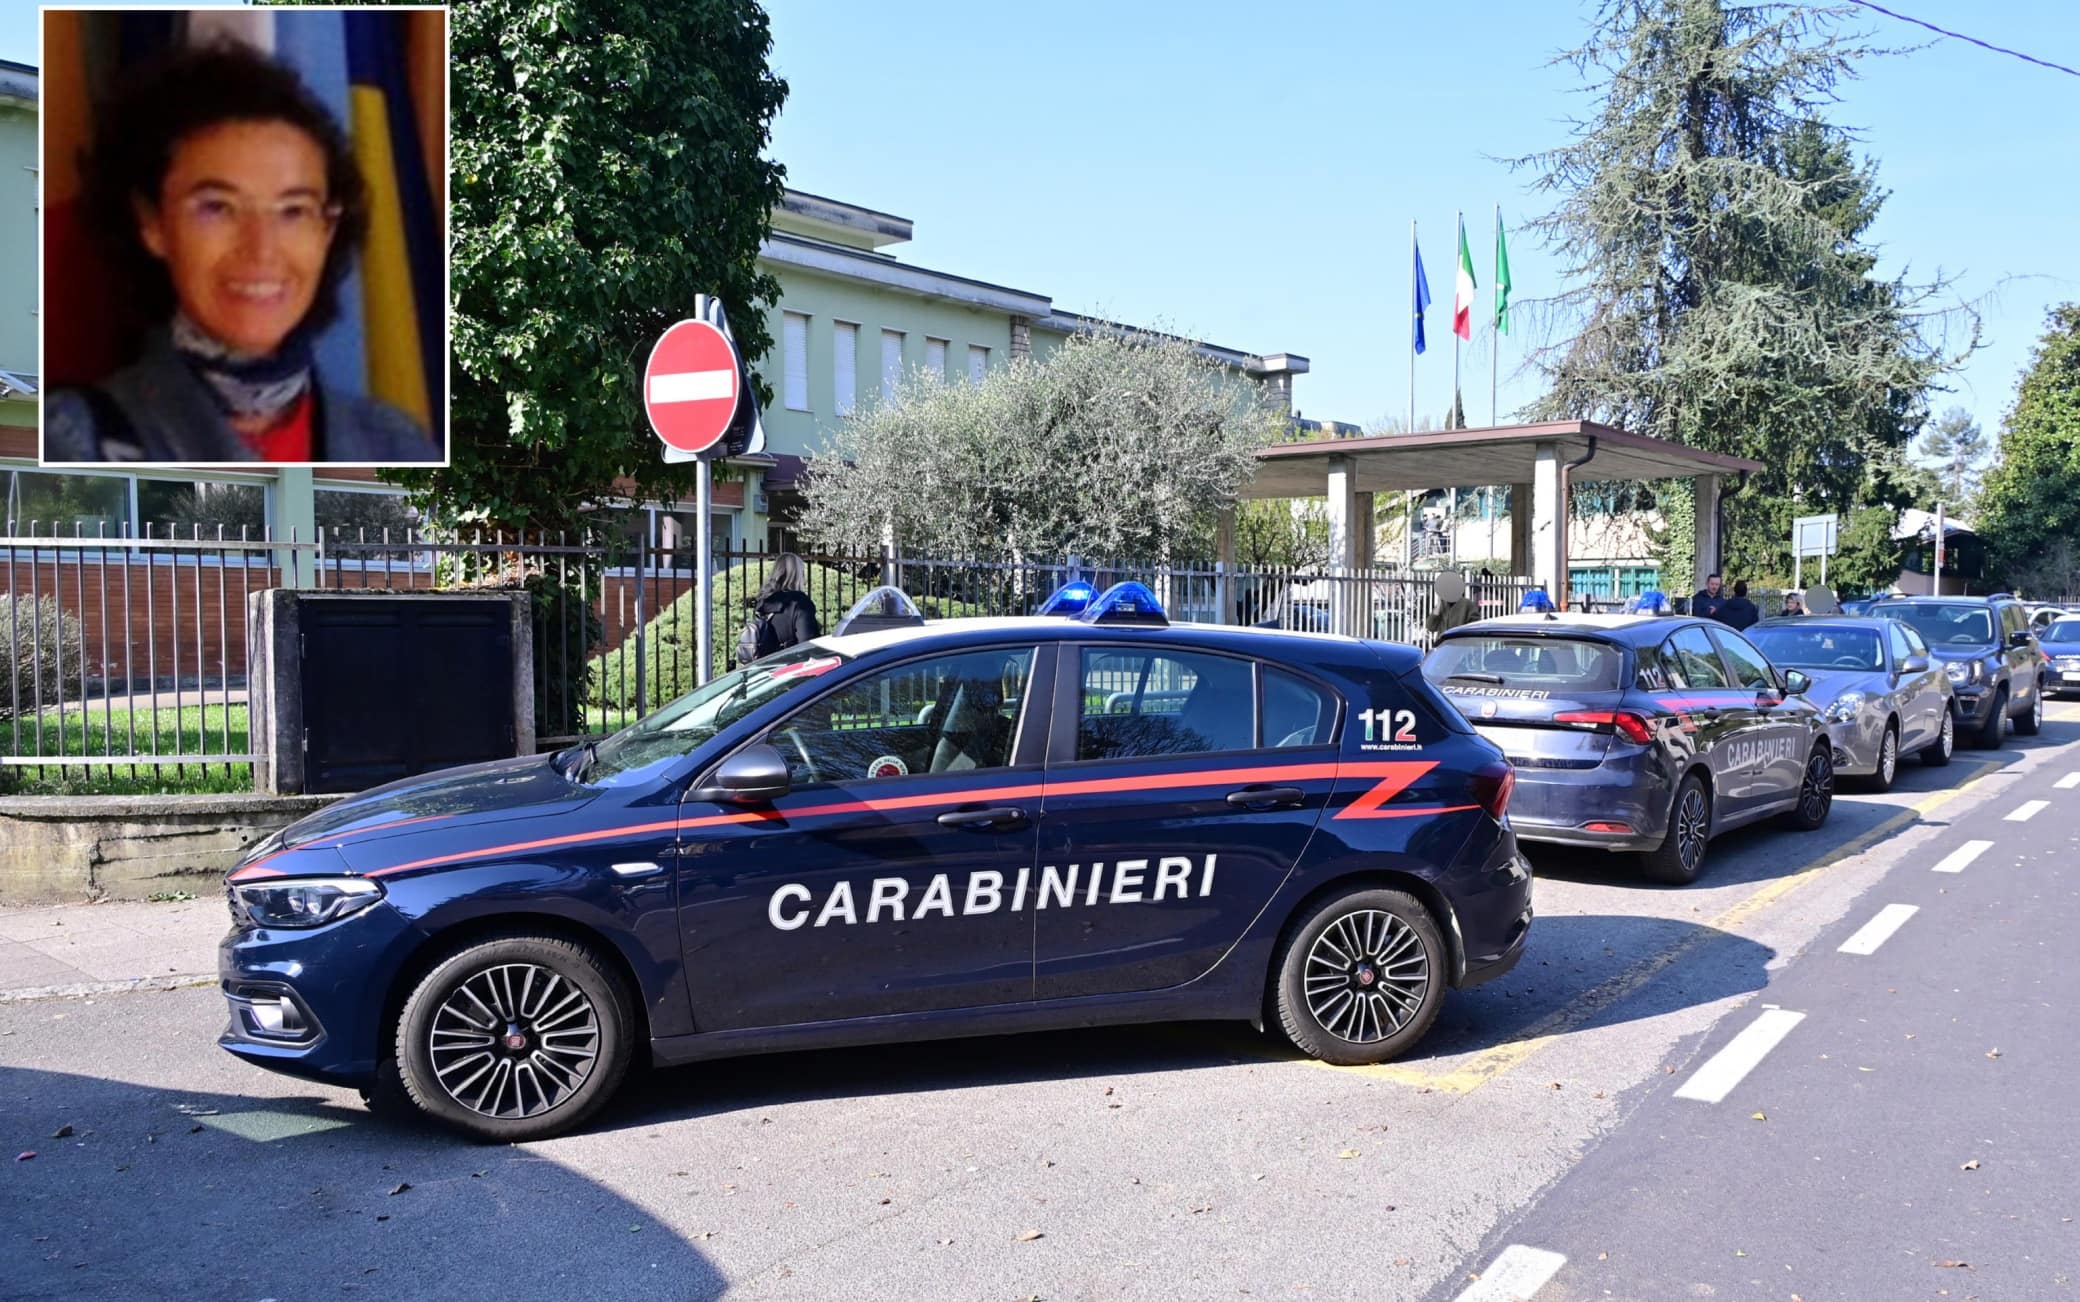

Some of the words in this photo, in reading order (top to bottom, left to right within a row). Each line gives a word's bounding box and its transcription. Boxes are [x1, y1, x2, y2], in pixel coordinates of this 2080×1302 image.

[1441, 686, 1550, 700] CARABINIERI
[1639, 667, 1665, 688] 112
[1358, 708, 1417, 742] 112
[1727, 736, 1796, 768] CARABINIERI
[768, 853, 1217, 931] CARABINIERI
